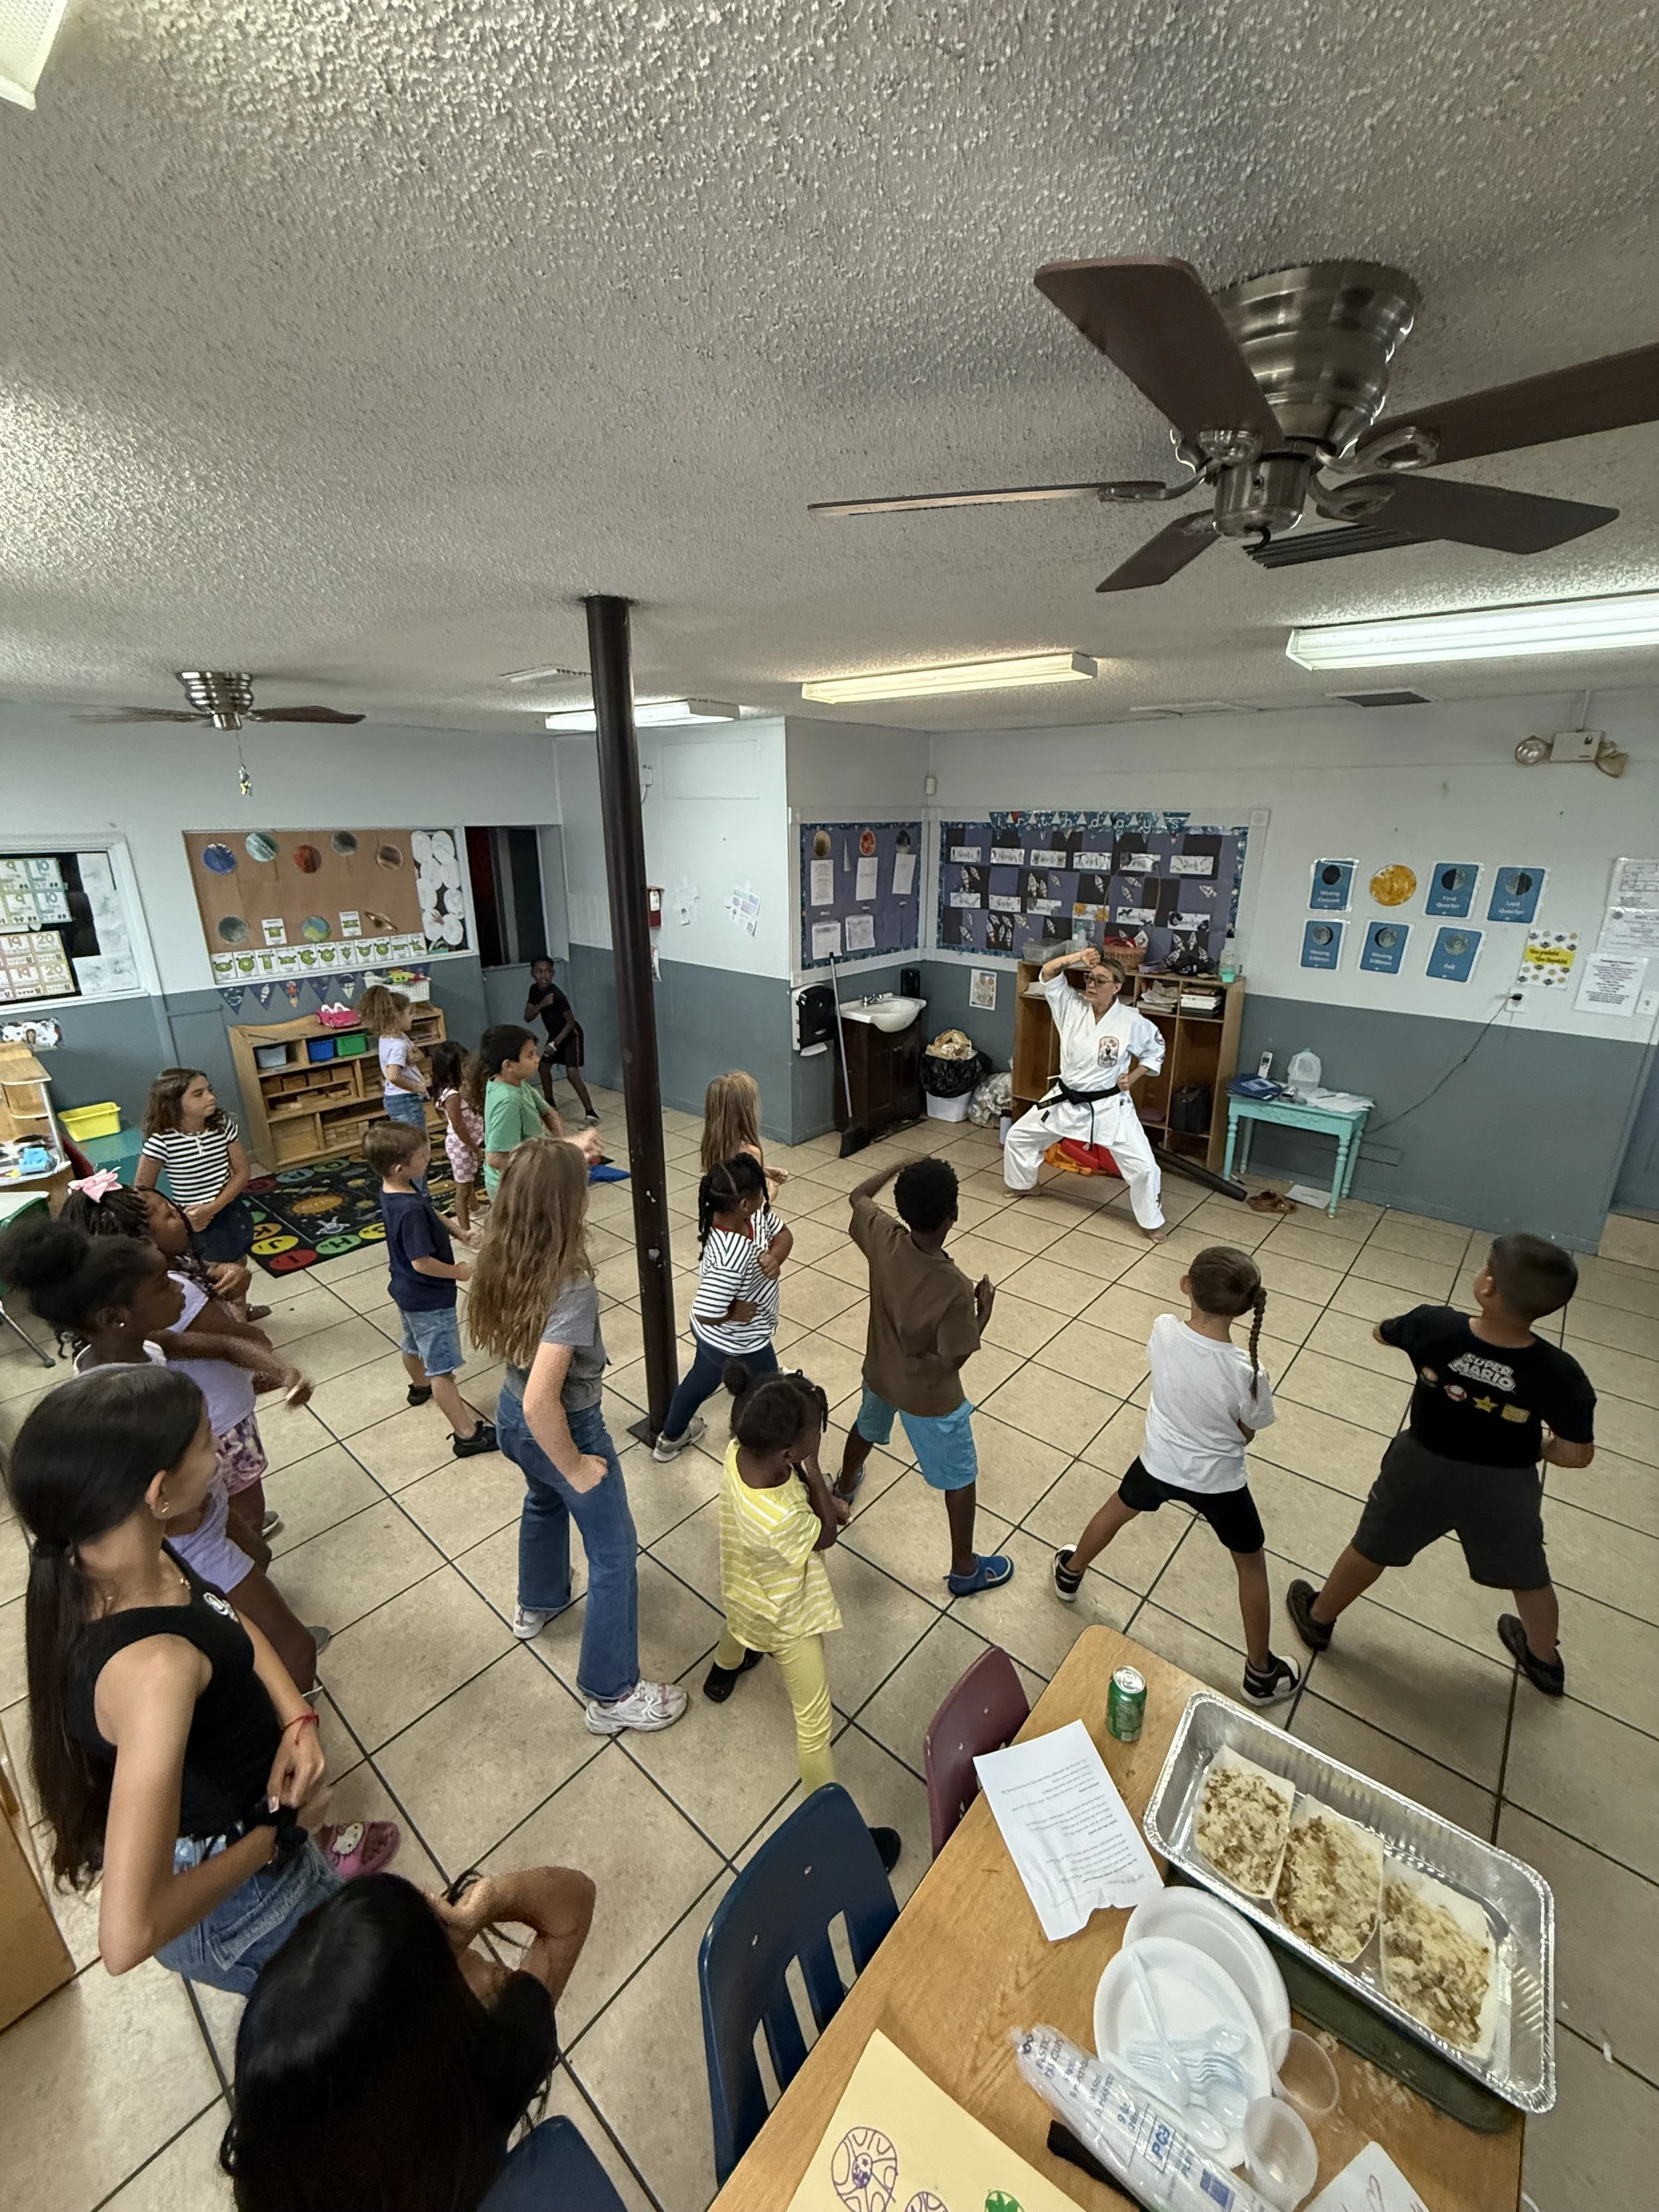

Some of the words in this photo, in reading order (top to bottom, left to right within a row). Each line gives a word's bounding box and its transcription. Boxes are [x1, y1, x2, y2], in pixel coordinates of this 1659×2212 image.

[36, 933, 54, 944] 20
[46, 964, 64, 976] 20
[1463, 1352, 1514, 1376] SUPER
[1449, 1359, 1515, 1390] MARIO
[1117, 2113, 1126, 2124] 9
